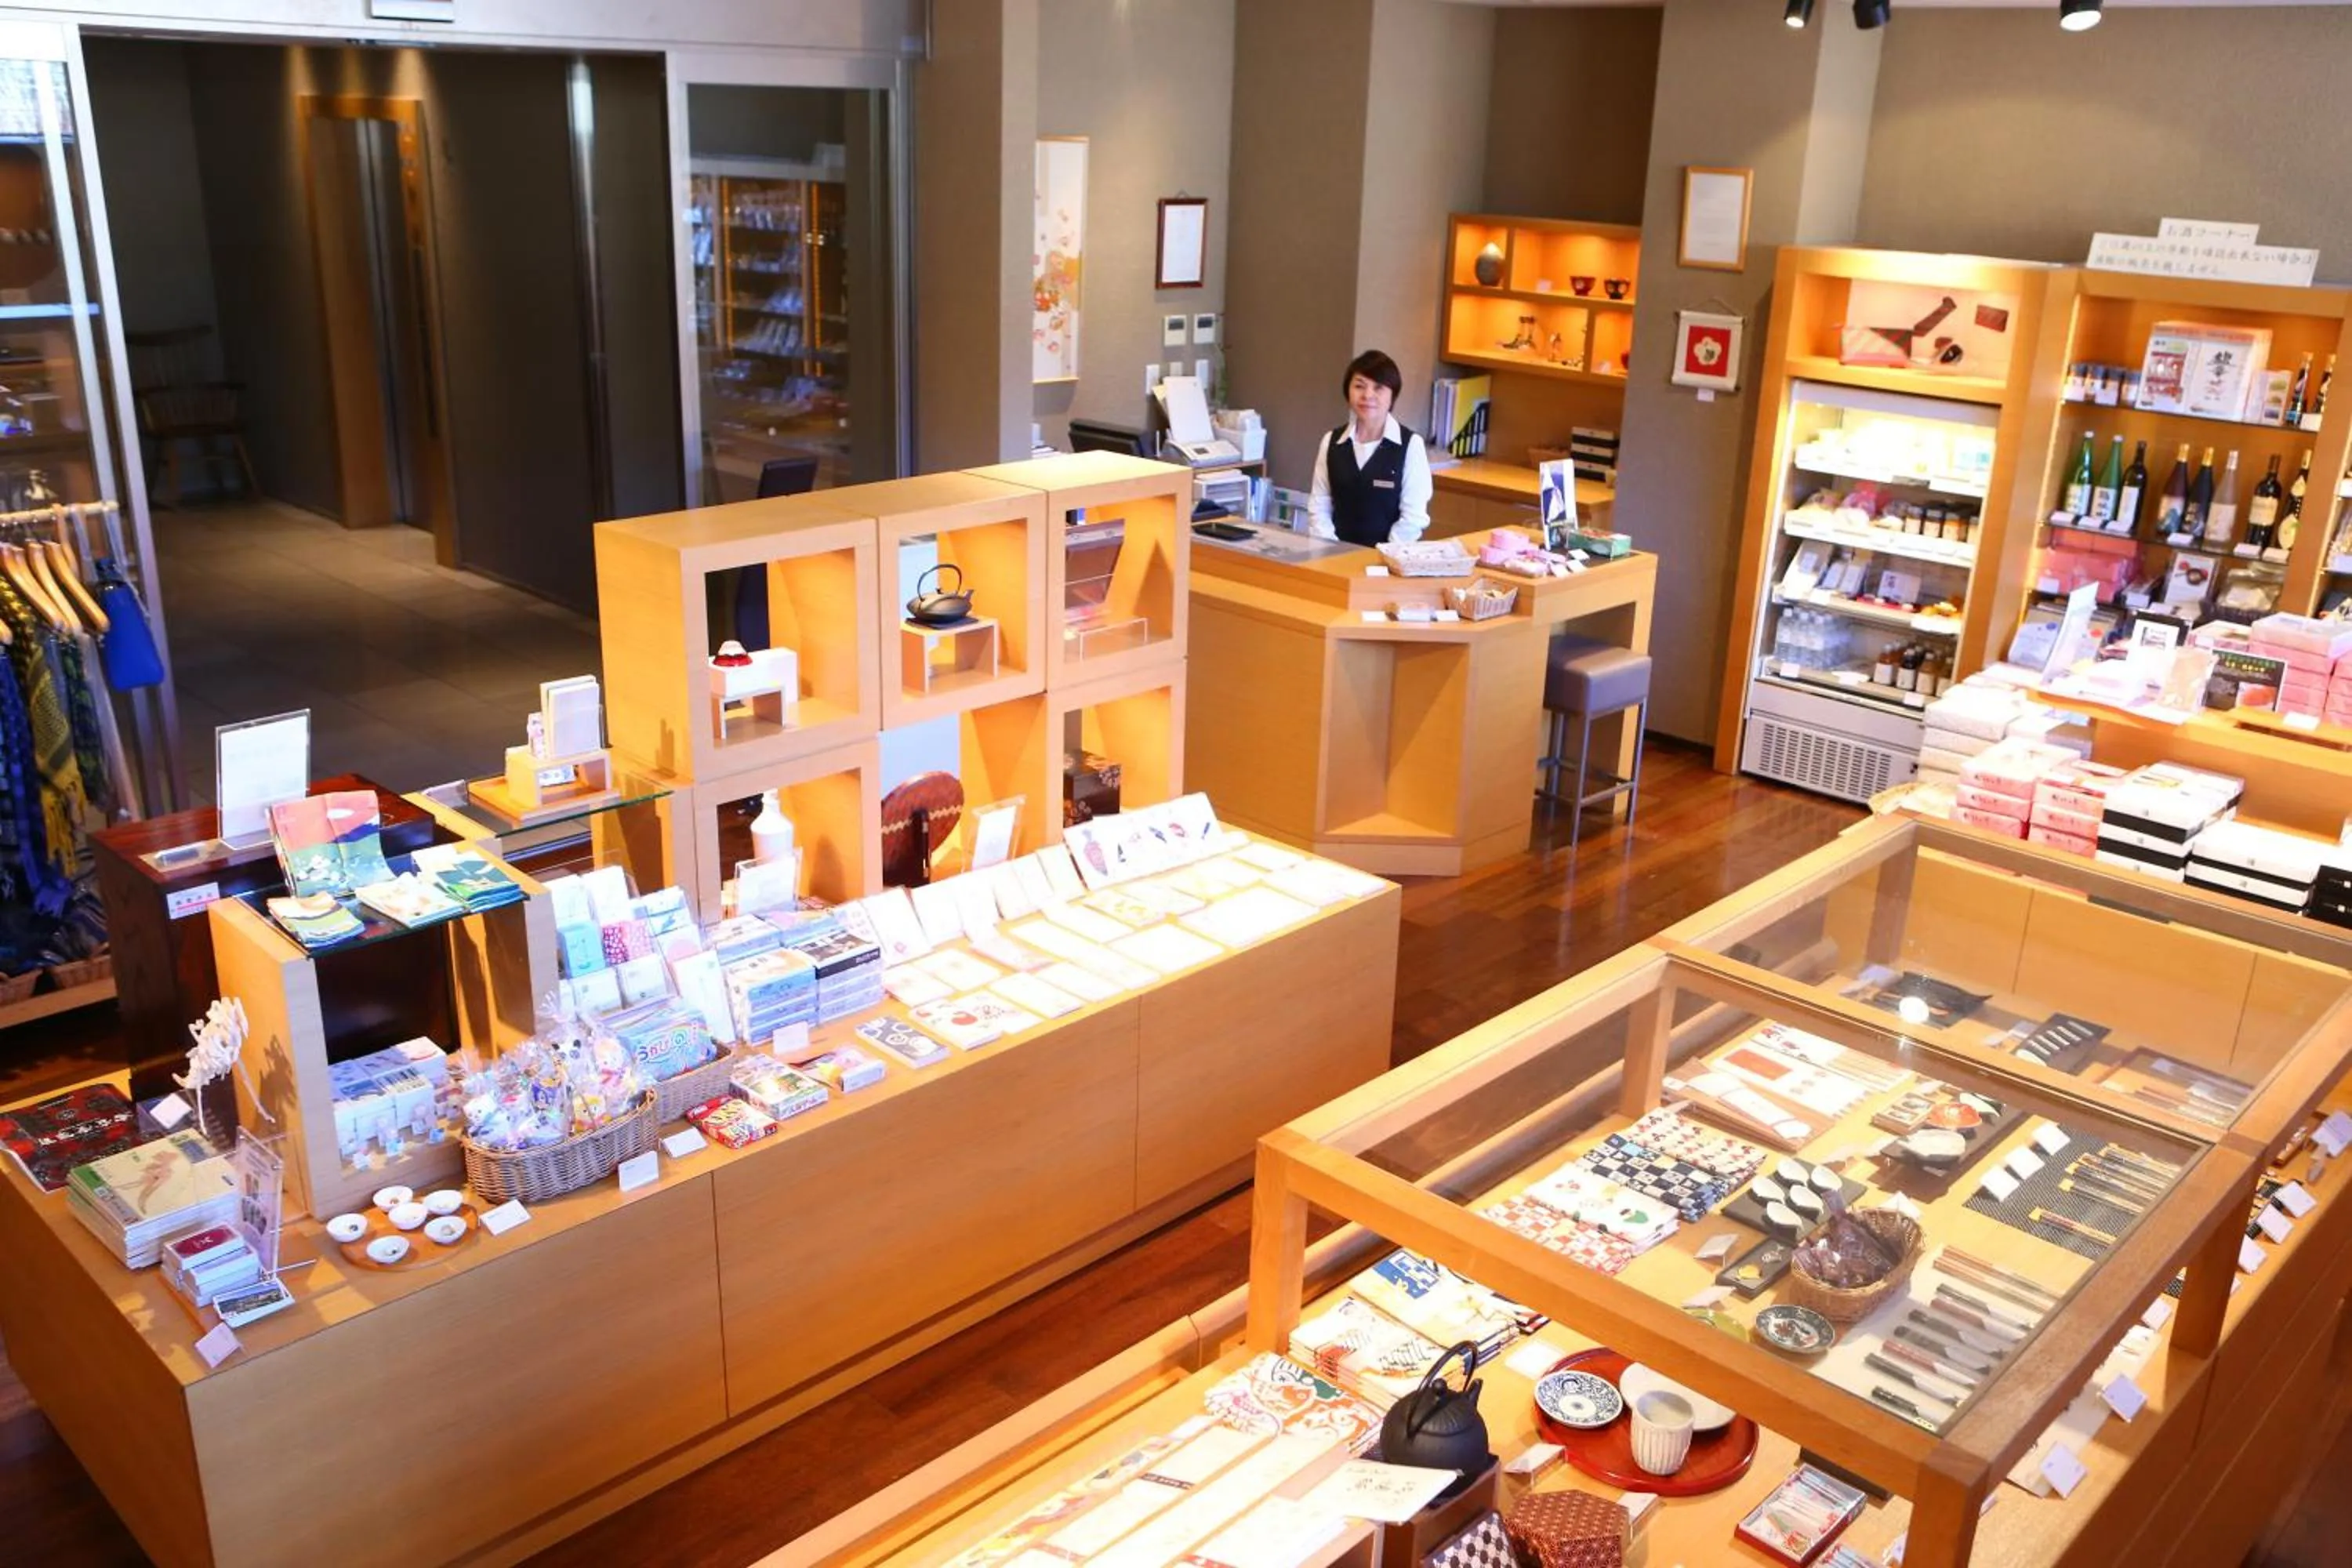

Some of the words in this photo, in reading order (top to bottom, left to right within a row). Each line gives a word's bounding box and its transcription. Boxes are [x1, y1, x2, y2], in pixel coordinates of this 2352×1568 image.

[2166, 226, 2251, 240] お酒コーナー
